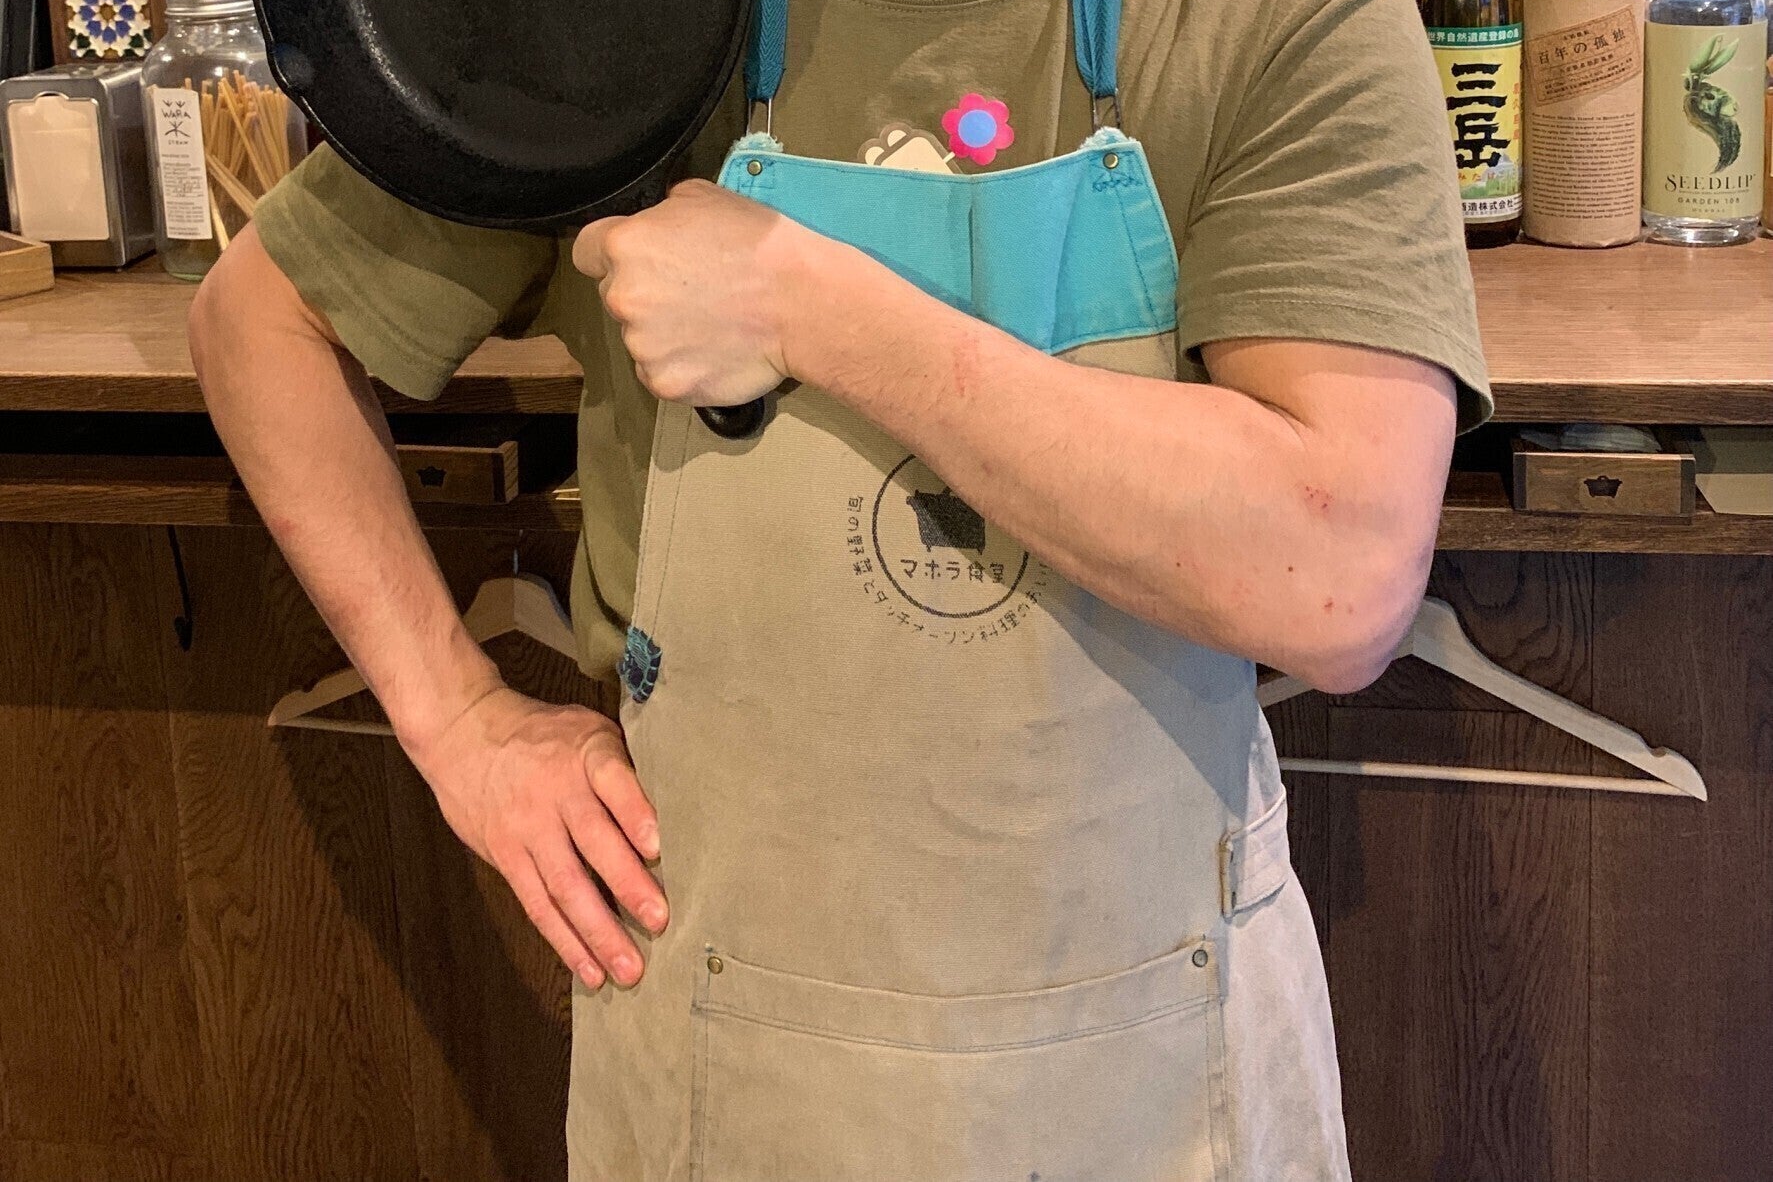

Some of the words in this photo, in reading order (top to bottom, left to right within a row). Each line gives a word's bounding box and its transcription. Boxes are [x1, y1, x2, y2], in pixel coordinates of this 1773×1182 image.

[1539, 28, 1626, 64] 百年の孤独
[1446, 63, 1511, 169] 三岳
[1665, 174, 1753, 192] SEEDLIP
[1677, 197, 1720, 205] GARDEN
